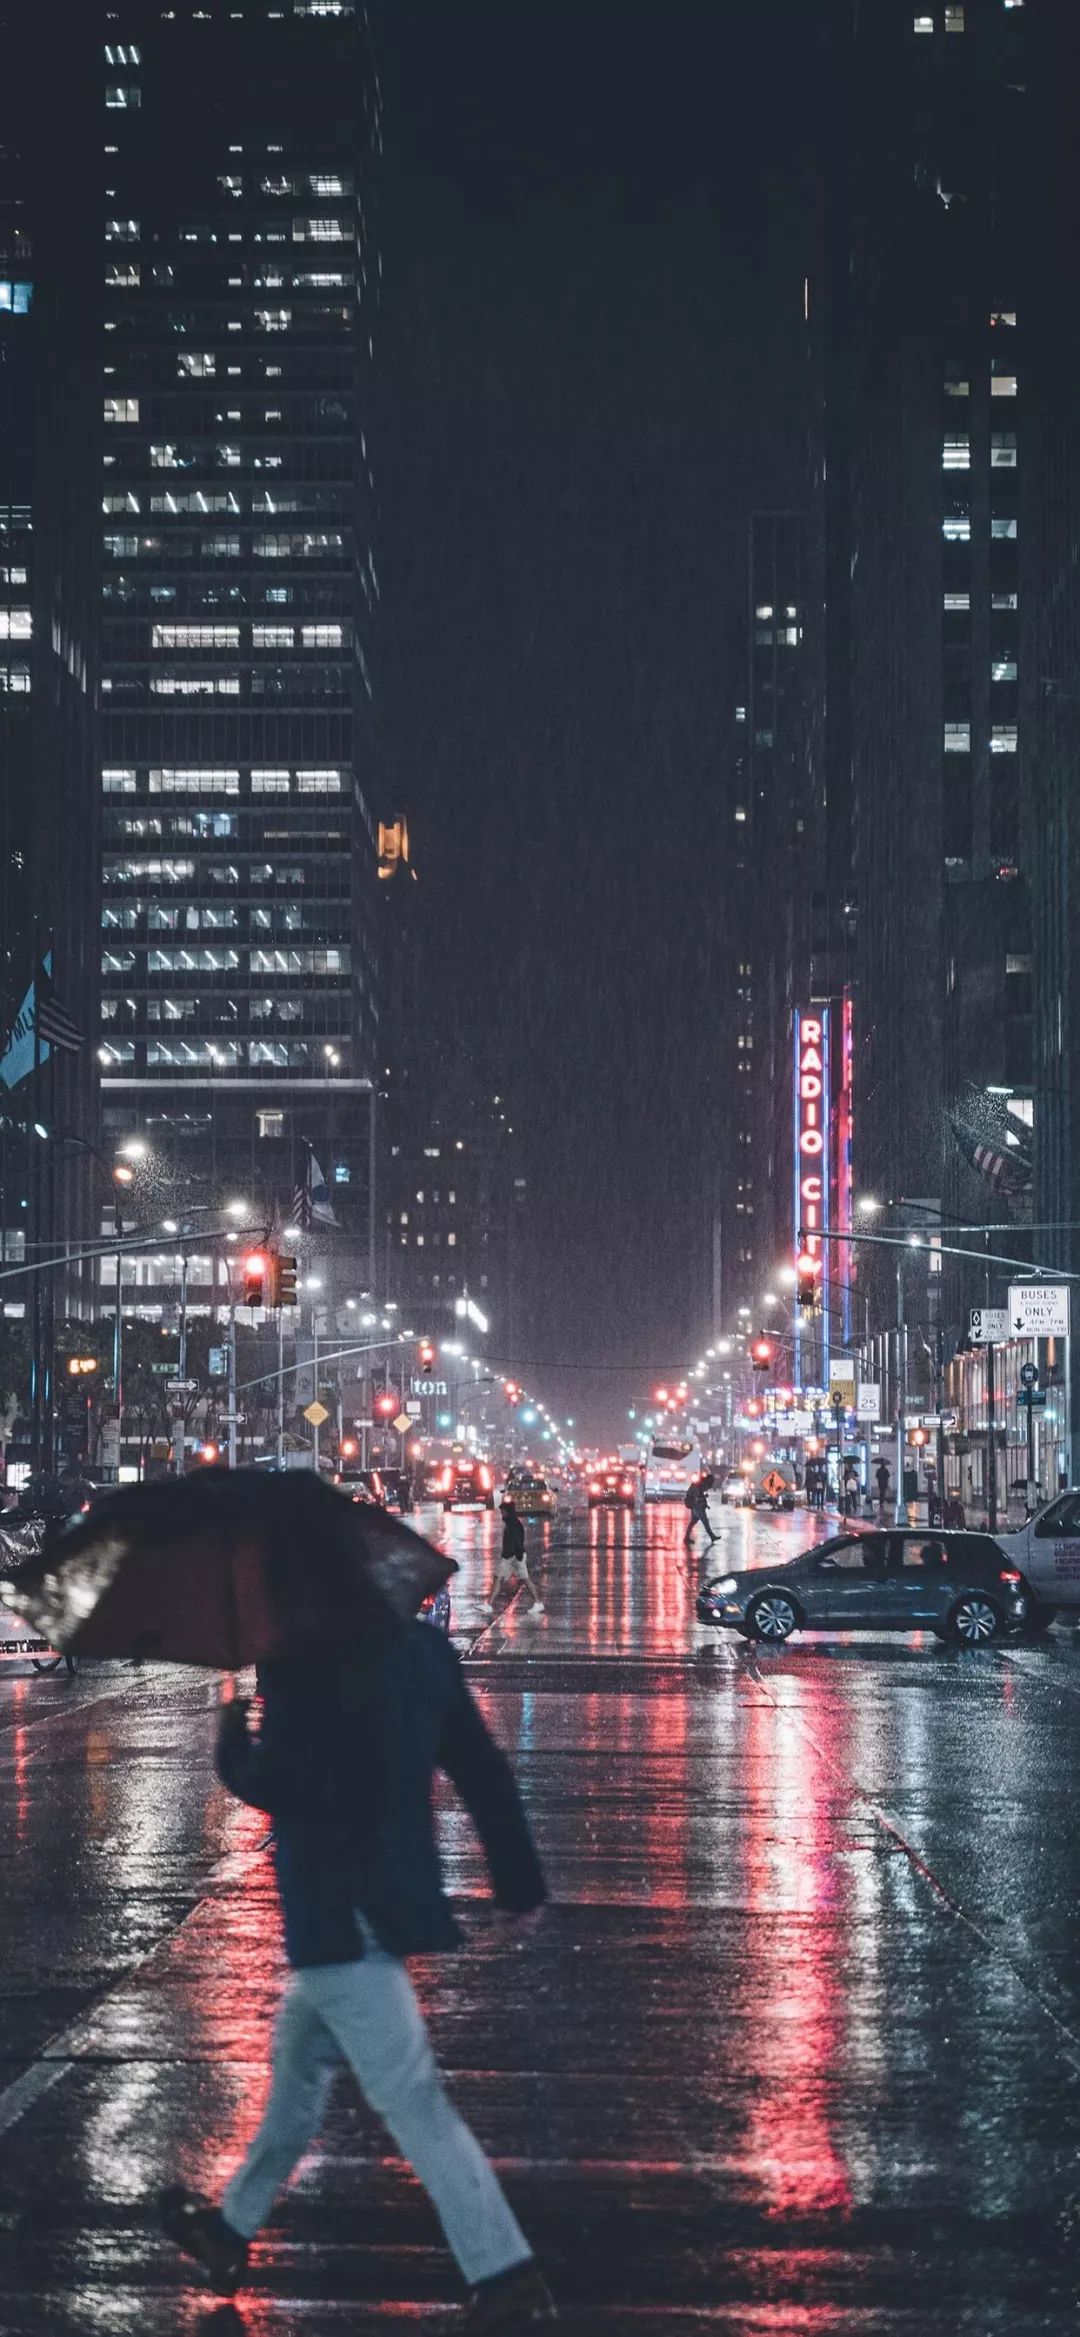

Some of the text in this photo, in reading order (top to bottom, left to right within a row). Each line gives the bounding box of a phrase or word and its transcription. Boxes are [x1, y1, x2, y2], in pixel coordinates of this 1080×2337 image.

[800, 1020, 823, 1153] RADIO
[1021, 1290, 1057, 1299] BUSES
[1025, 1307, 1053, 1316] ONLY
[861, 1398, 877, 1408] 25
